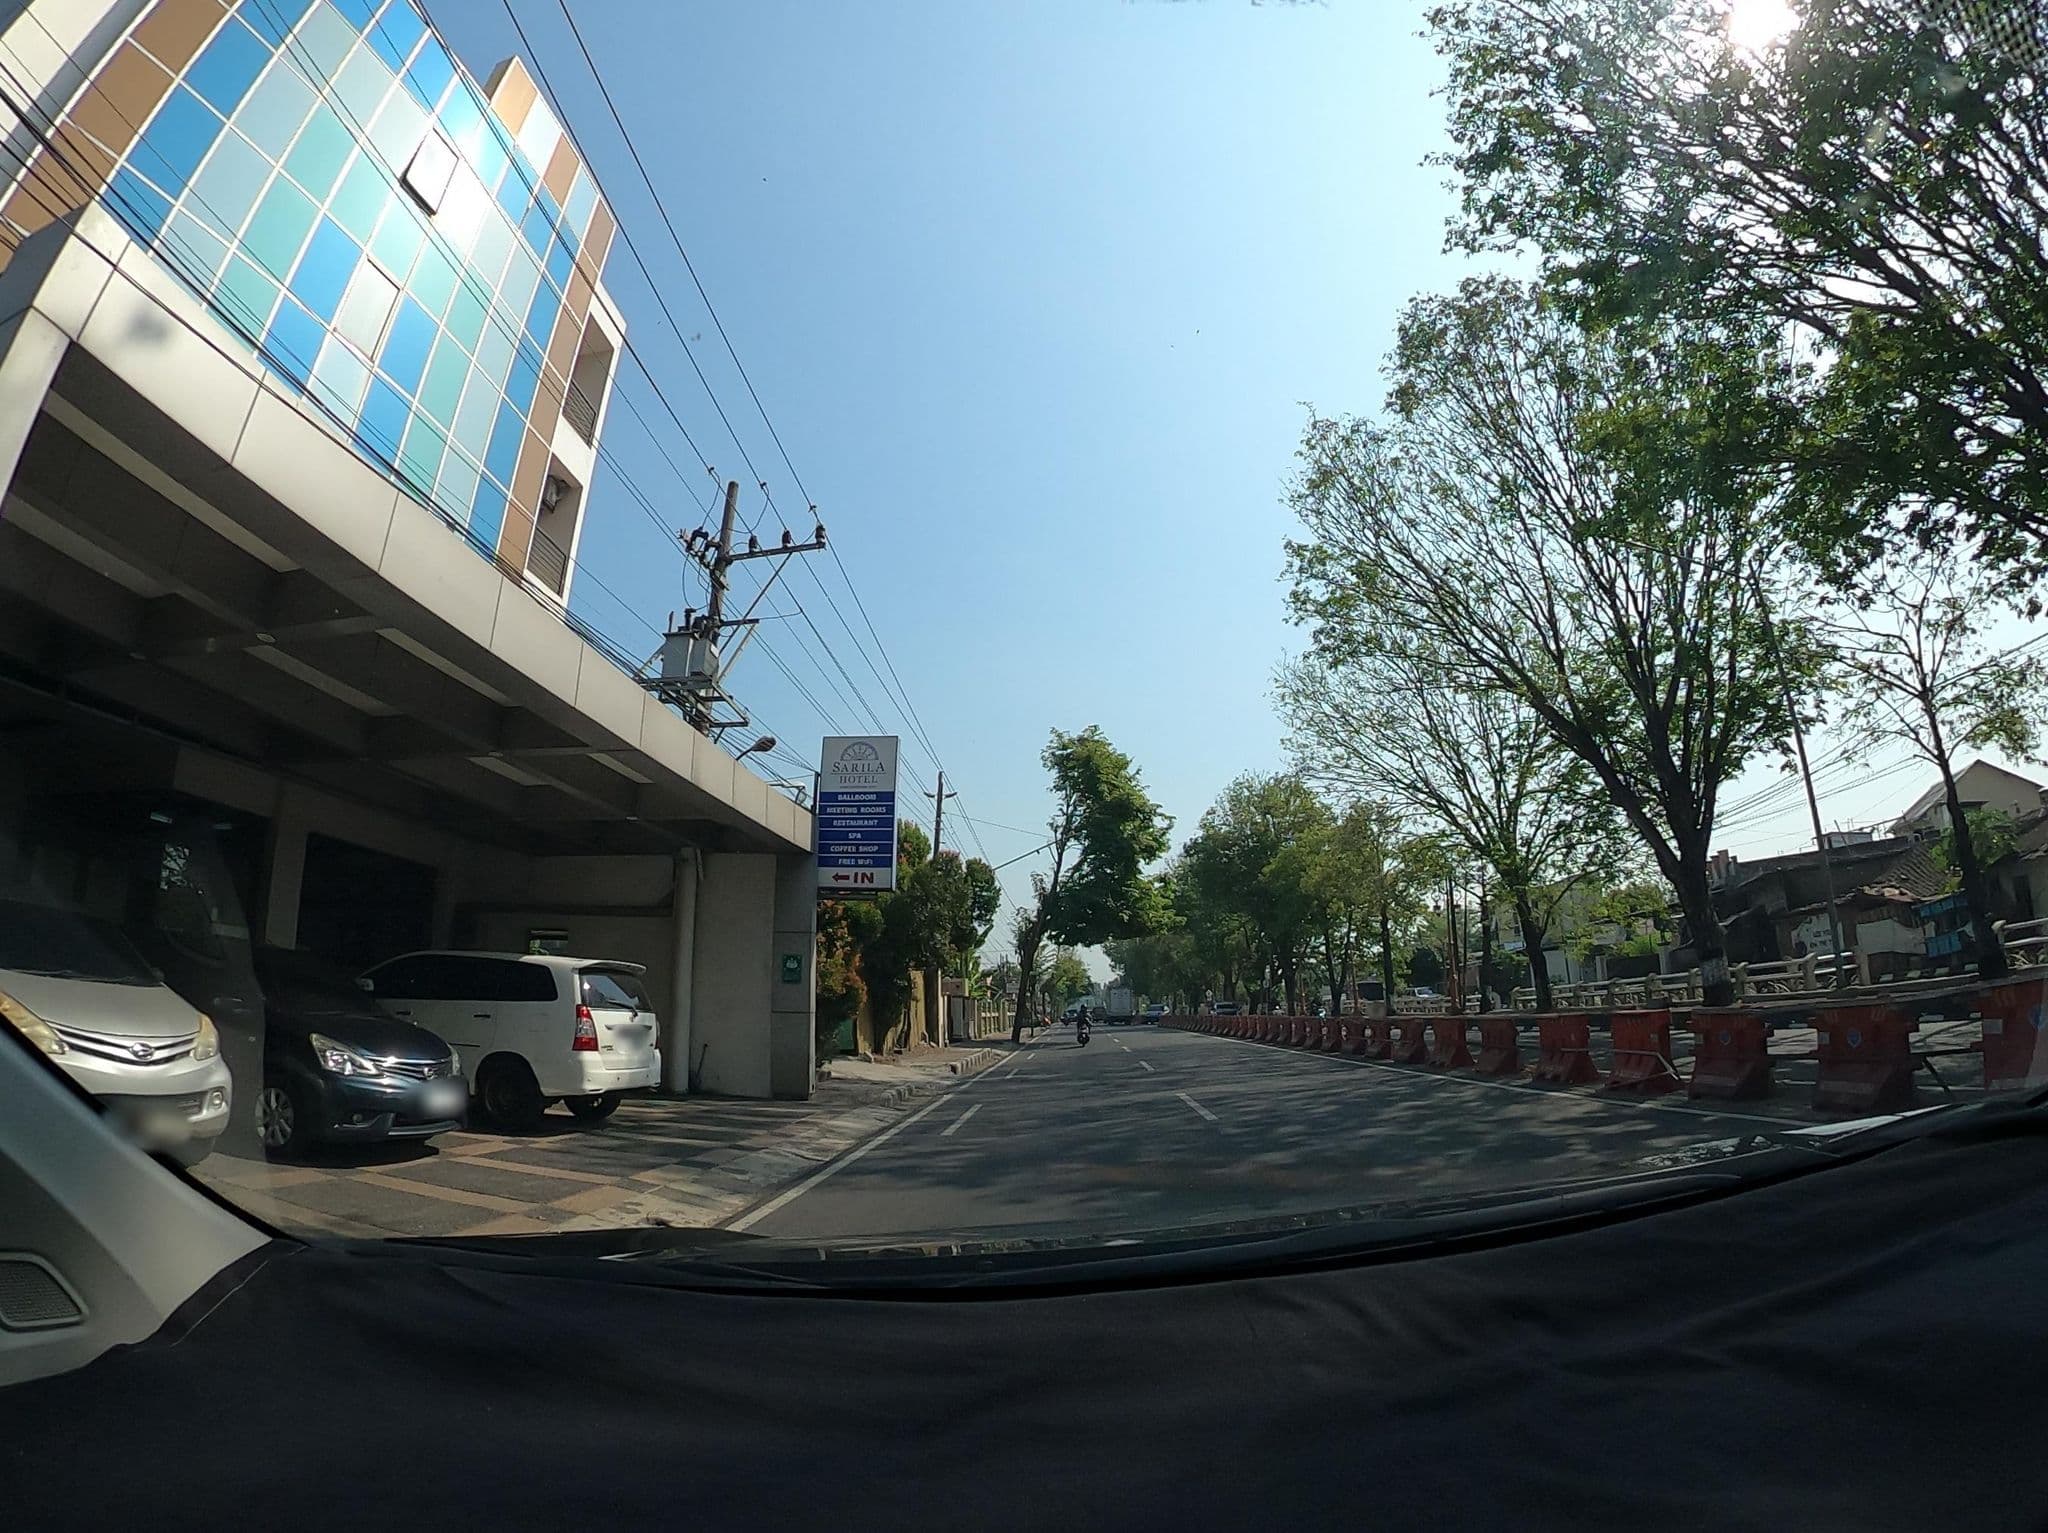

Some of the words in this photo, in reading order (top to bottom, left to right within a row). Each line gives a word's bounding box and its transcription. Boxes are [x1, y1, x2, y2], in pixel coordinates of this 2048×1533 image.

[833, 761, 885, 773] SARILA
[839, 775, 878, 784] HOTEL
[854, 872, 874, 884] IN
